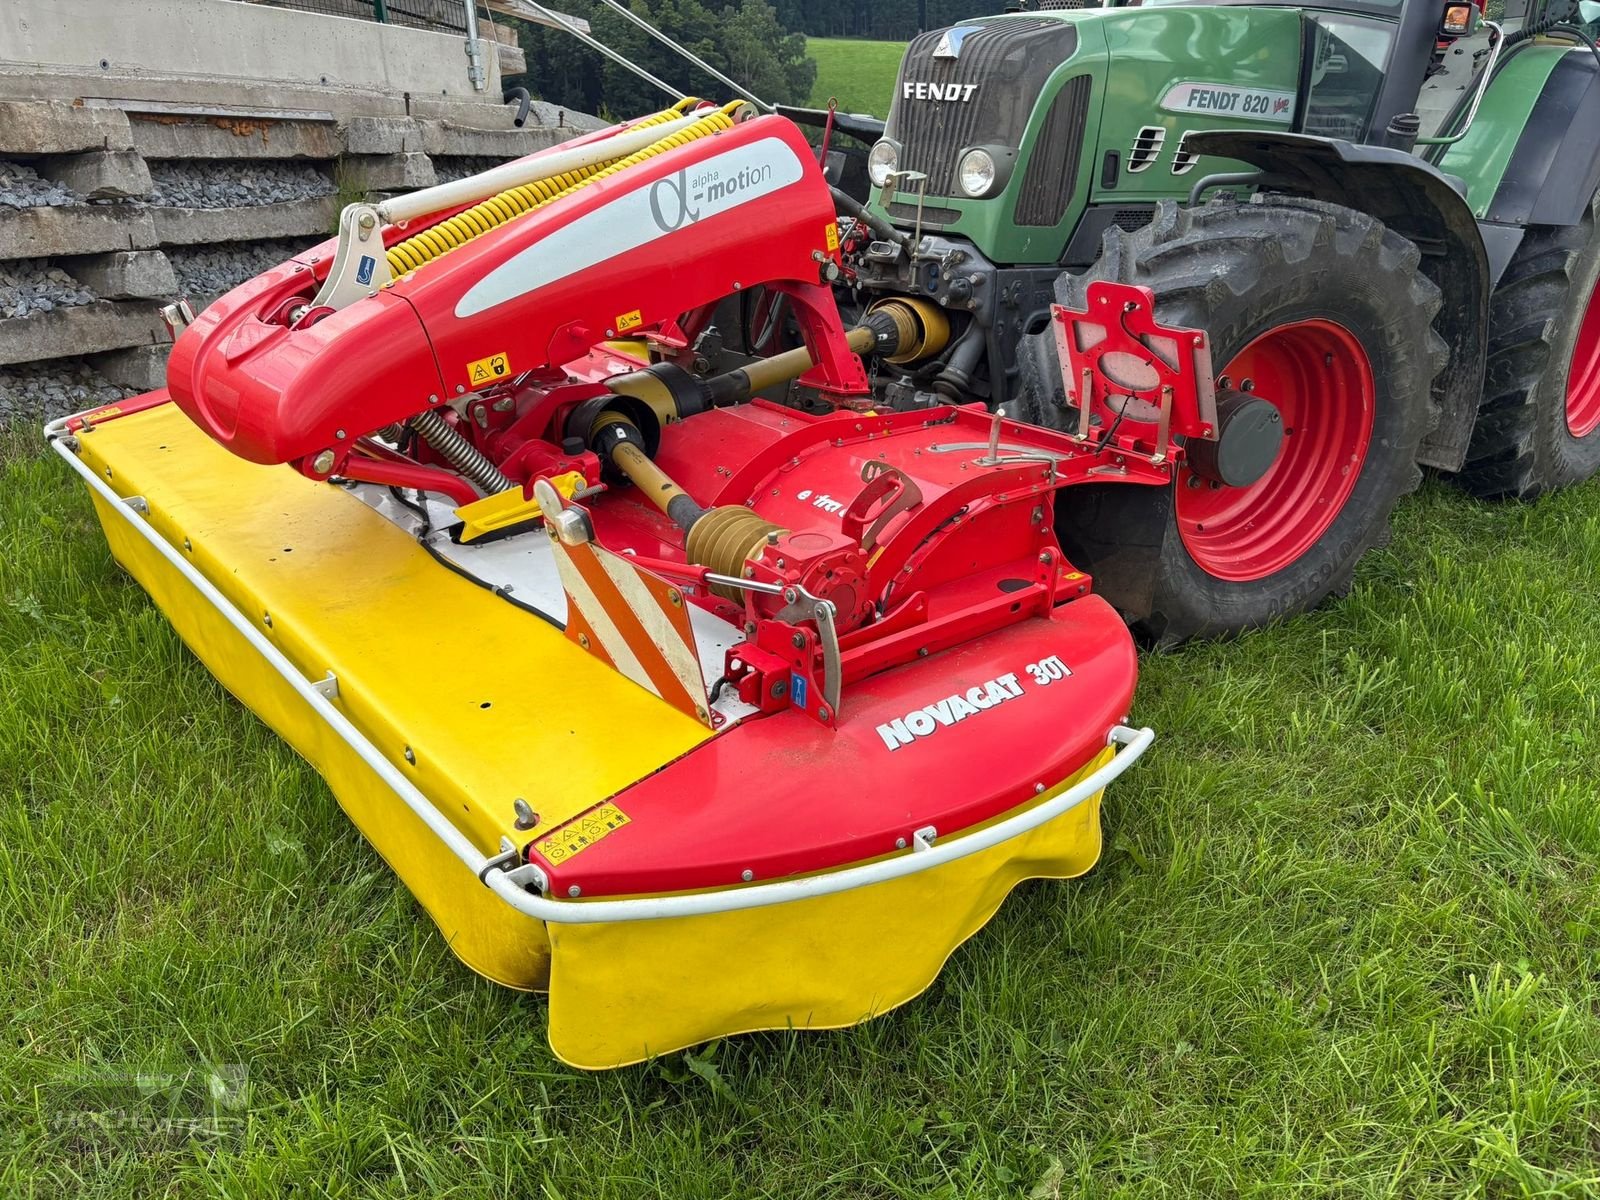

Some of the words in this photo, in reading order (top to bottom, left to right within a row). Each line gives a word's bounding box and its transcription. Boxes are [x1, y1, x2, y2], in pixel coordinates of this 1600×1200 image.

[903, 82, 978, 102] FENDT
[1187, 88, 1240, 111] FENDT
[1242, 94, 1270, 114] 820
[692, 171, 719, 189] alpha
[875, 672, 1025, 751] NOVACAT
